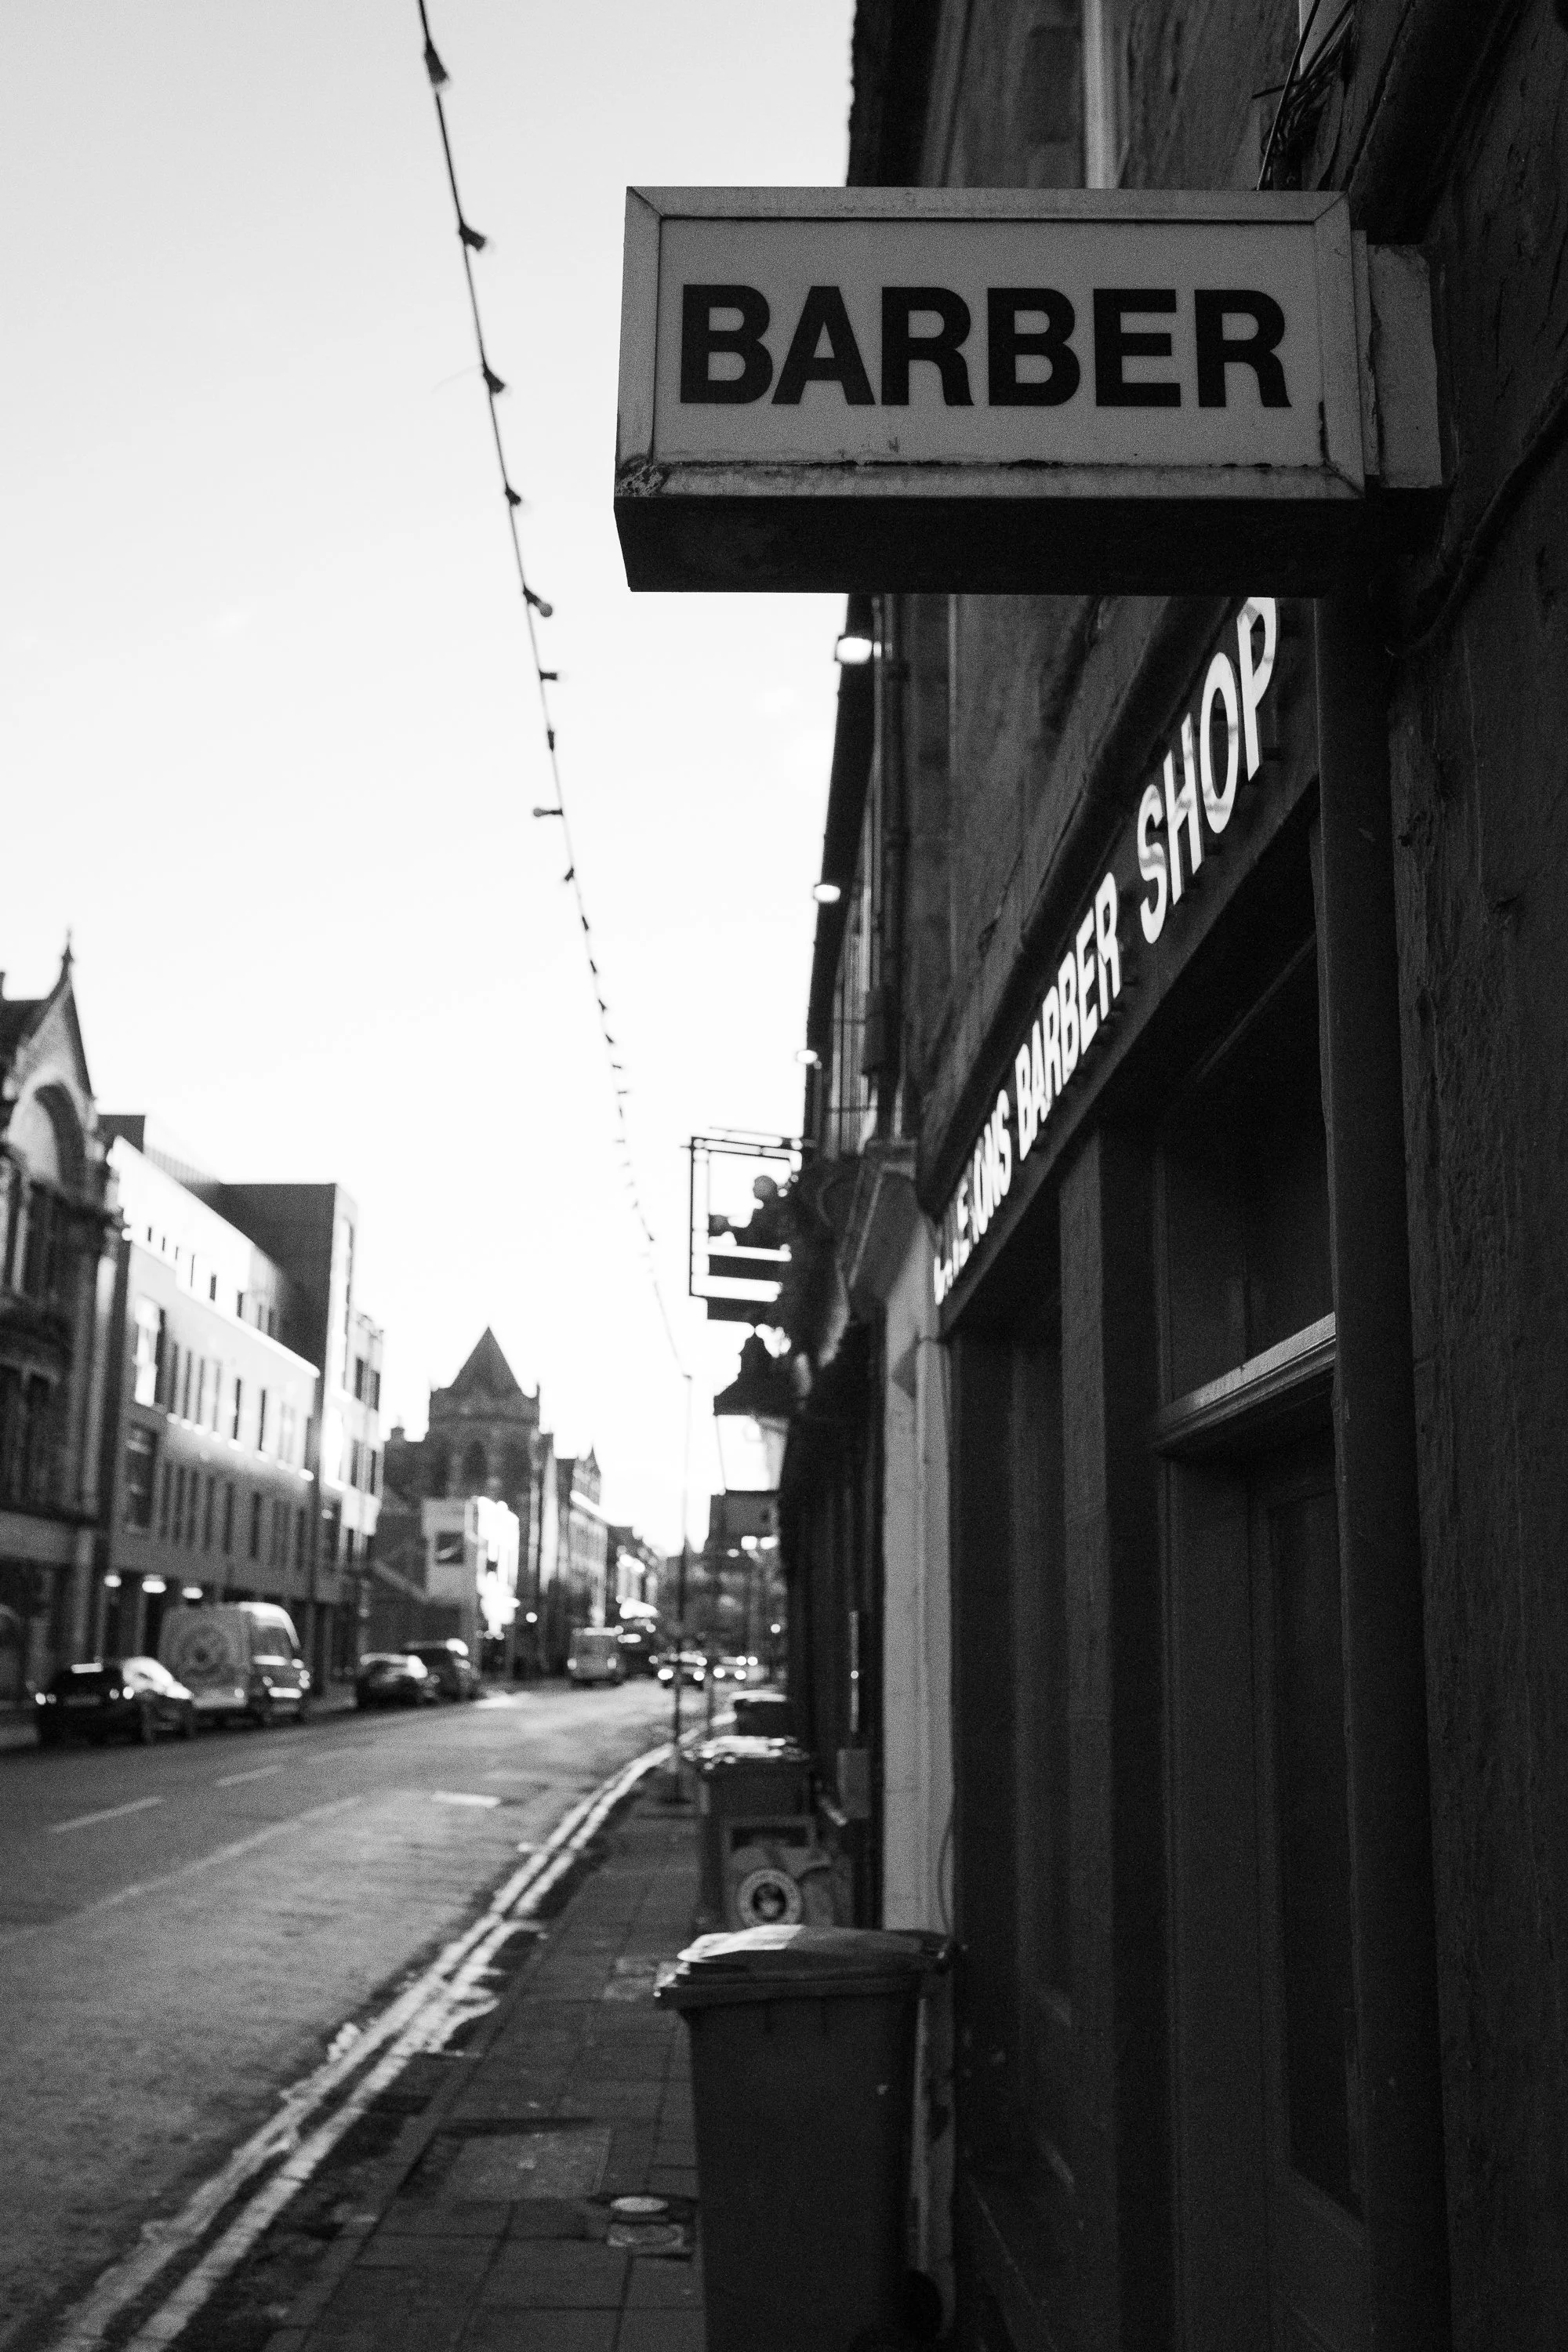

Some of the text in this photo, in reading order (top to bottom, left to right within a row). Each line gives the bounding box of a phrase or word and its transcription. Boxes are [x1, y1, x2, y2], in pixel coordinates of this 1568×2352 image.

[679, 283, 1293, 411] BARBER
[1014, 872, 1121, 1161] BARBER
[1137, 597, 1277, 944] SHOP
